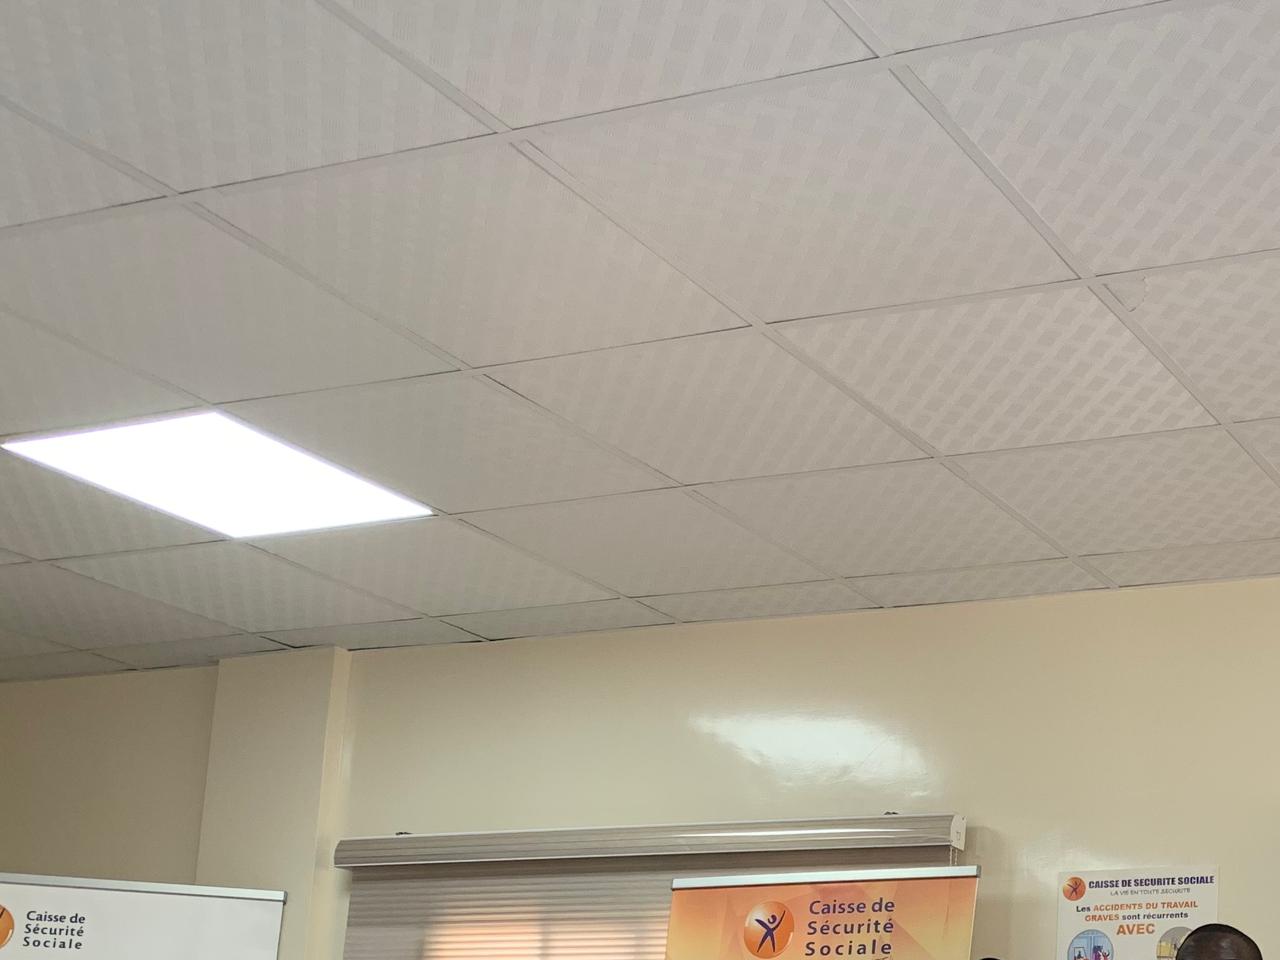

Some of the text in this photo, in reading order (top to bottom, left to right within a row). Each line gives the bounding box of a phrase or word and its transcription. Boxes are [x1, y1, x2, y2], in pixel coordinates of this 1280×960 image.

[1088, 875, 1214, 889] CAISSE DE SECURITE SOCIALE
[809, 897, 895, 915] Caisse de
[1076, 900, 1198, 913] Les ACCIDENTS DU TRAVAIL
[26, 910, 86, 924] Caisse de
[1085, 911, 1189, 922] GRAVES sont récurrents
[24, 923, 85, 937] Sécurité
[807, 918, 894, 936] Sécurité
[1116, 923, 1156, 936] AVEC
[22, 936, 83, 950] Sociale
[805, 938, 892, 957] Sociale
